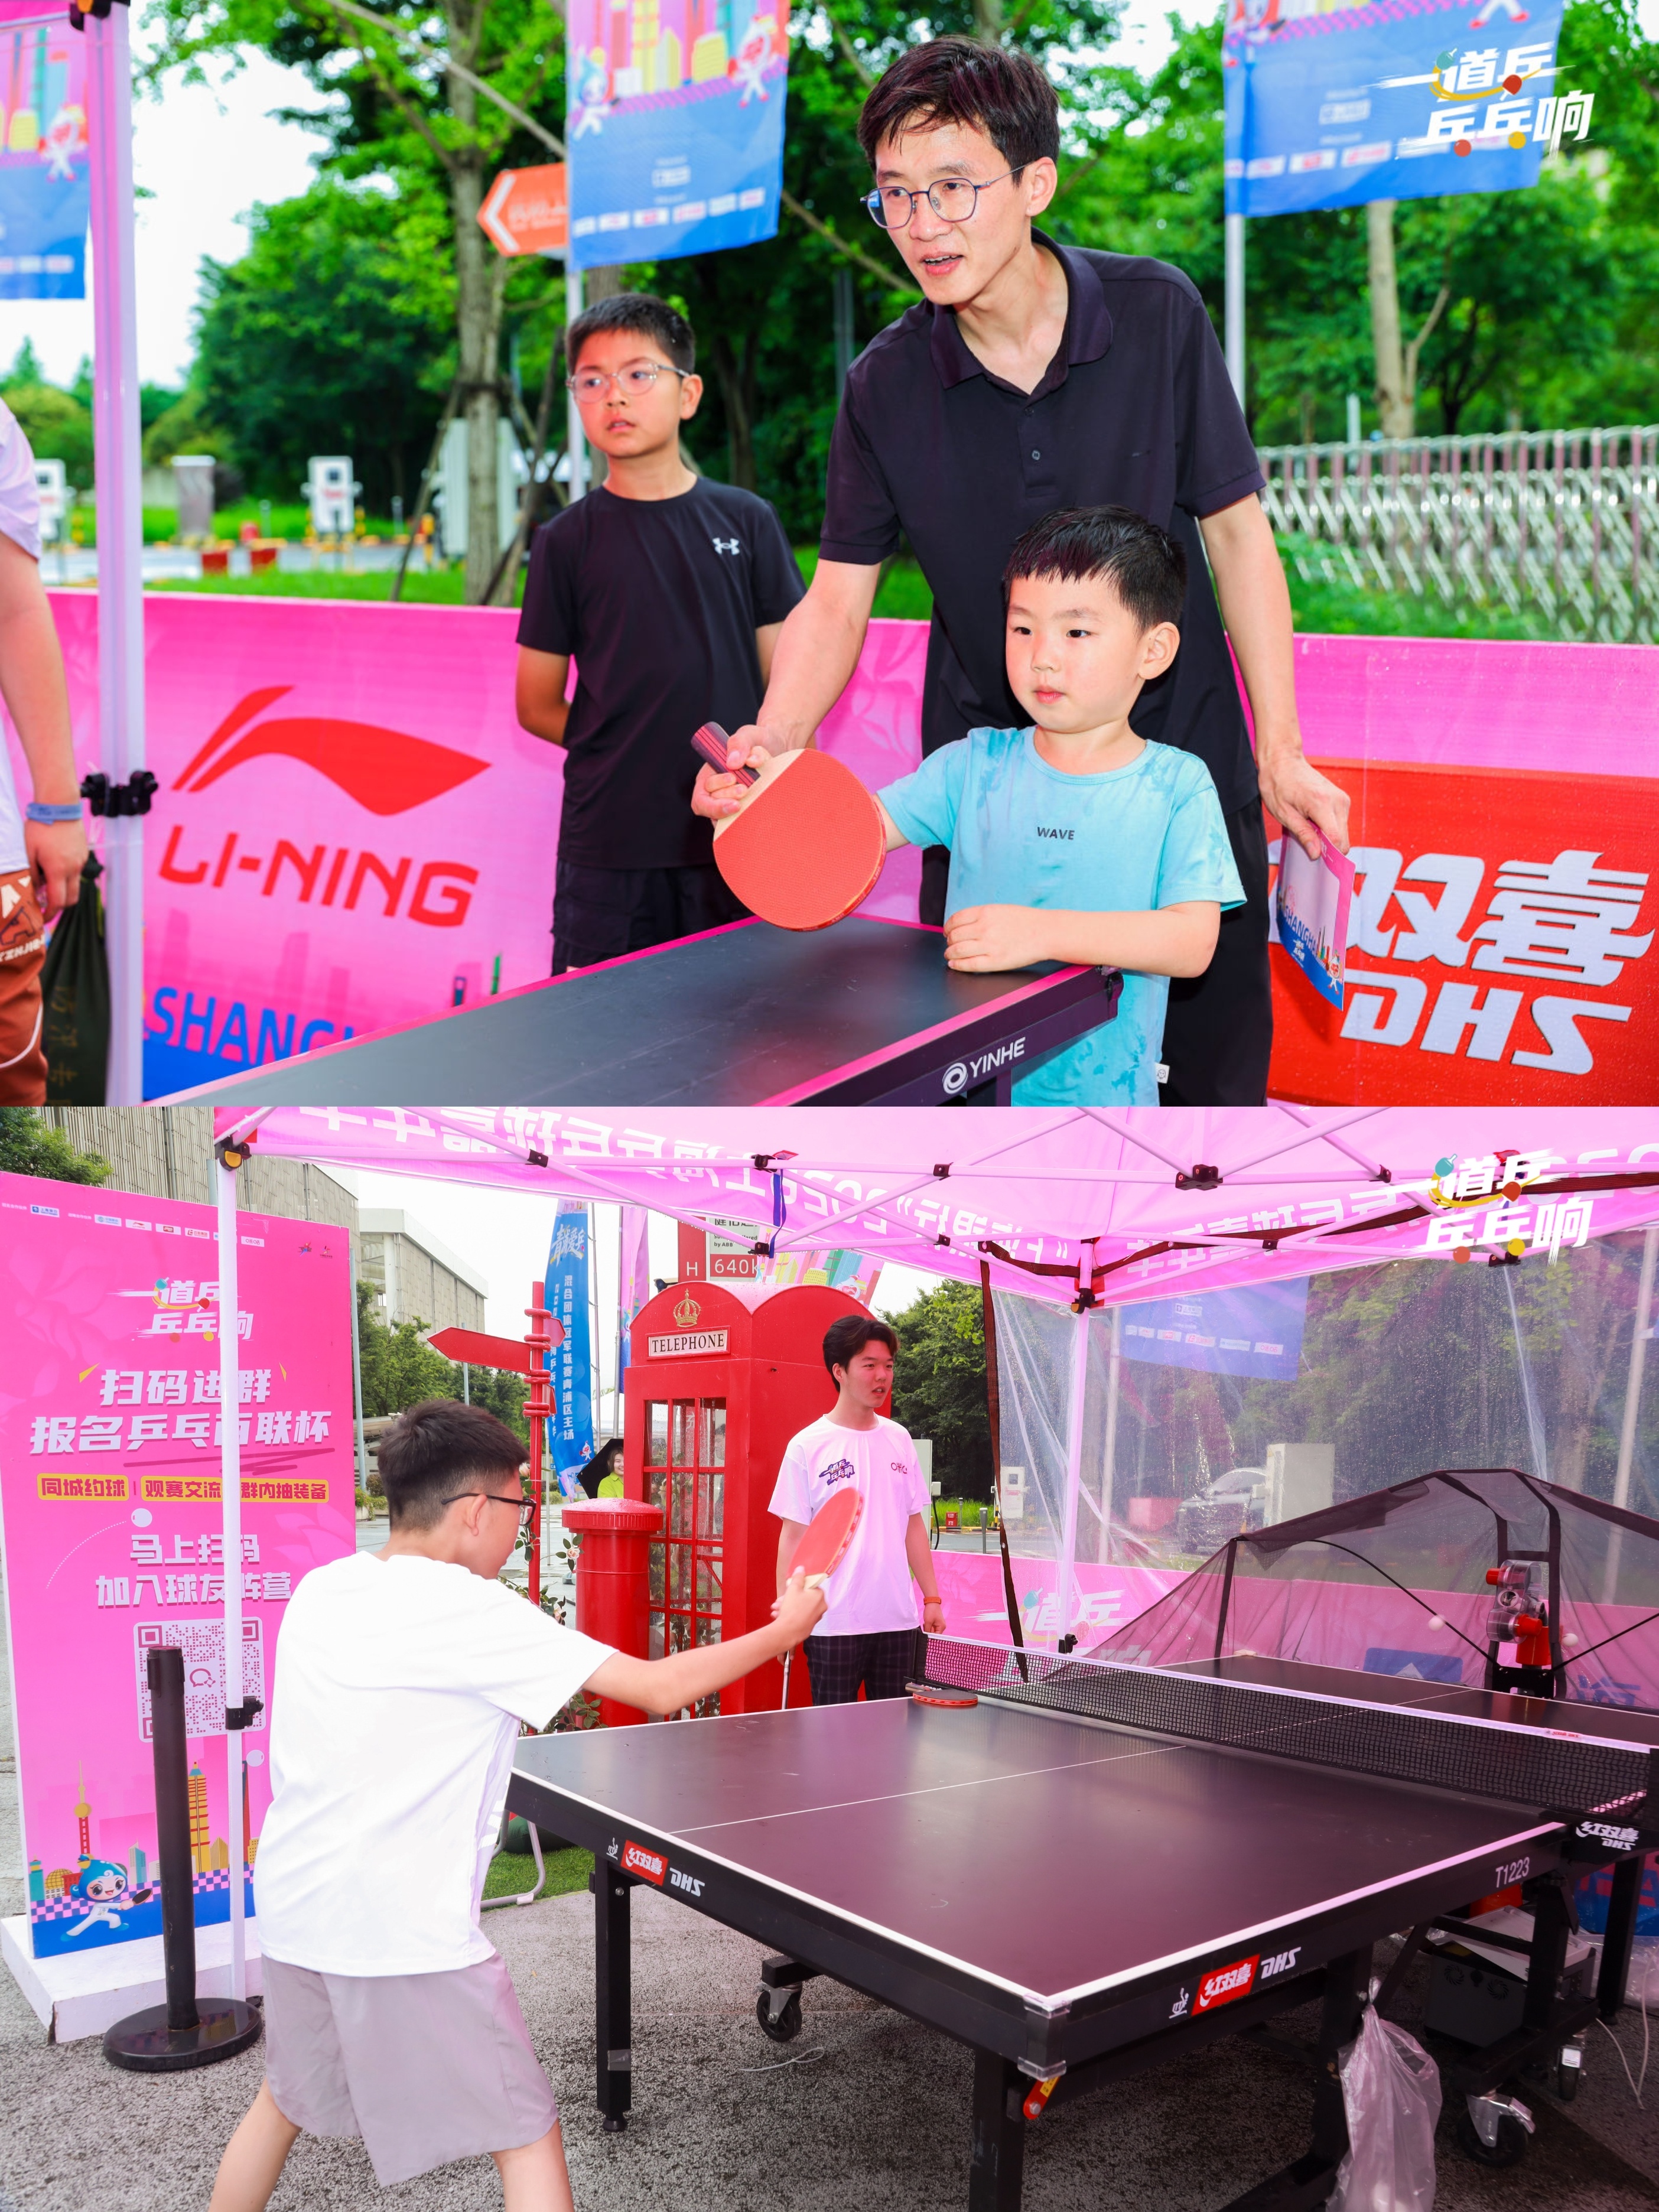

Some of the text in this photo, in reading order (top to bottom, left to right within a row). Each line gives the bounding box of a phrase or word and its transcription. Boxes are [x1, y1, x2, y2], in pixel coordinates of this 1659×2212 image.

[1037, 827, 1075, 840] WAVE
[158, 825, 480, 928] LI-NING
[1268, 841, 1655, 987] 双喜
[1340, 968, 1632, 1075] DHS
[970, 1037, 1026, 1079] YINHE
[652, 1333, 724, 1353] TELEPHONE
[100, 1369, 271, 1406] 扫码进群
[41, 1478, 126, 1497] 同城约球
[145, 1480, 222, 1499] 观赛交流
[240, 1482, 327, 1500] 群内抽装备
[130, 1534, 260, 1566] 马上扫码
[96, 1572, 291, 1607] 加入球友阵营
[1576, 1821, 1640, 1842] 红双喜
[1601, 1837, 1636, 1850] DHS
[626, 1847, 705, 1897] 红双喜 DHS
[1495, 1856, 1530, 1888] T1223
[1199, 1947, 1302, 2007] 红双喜 DHS
